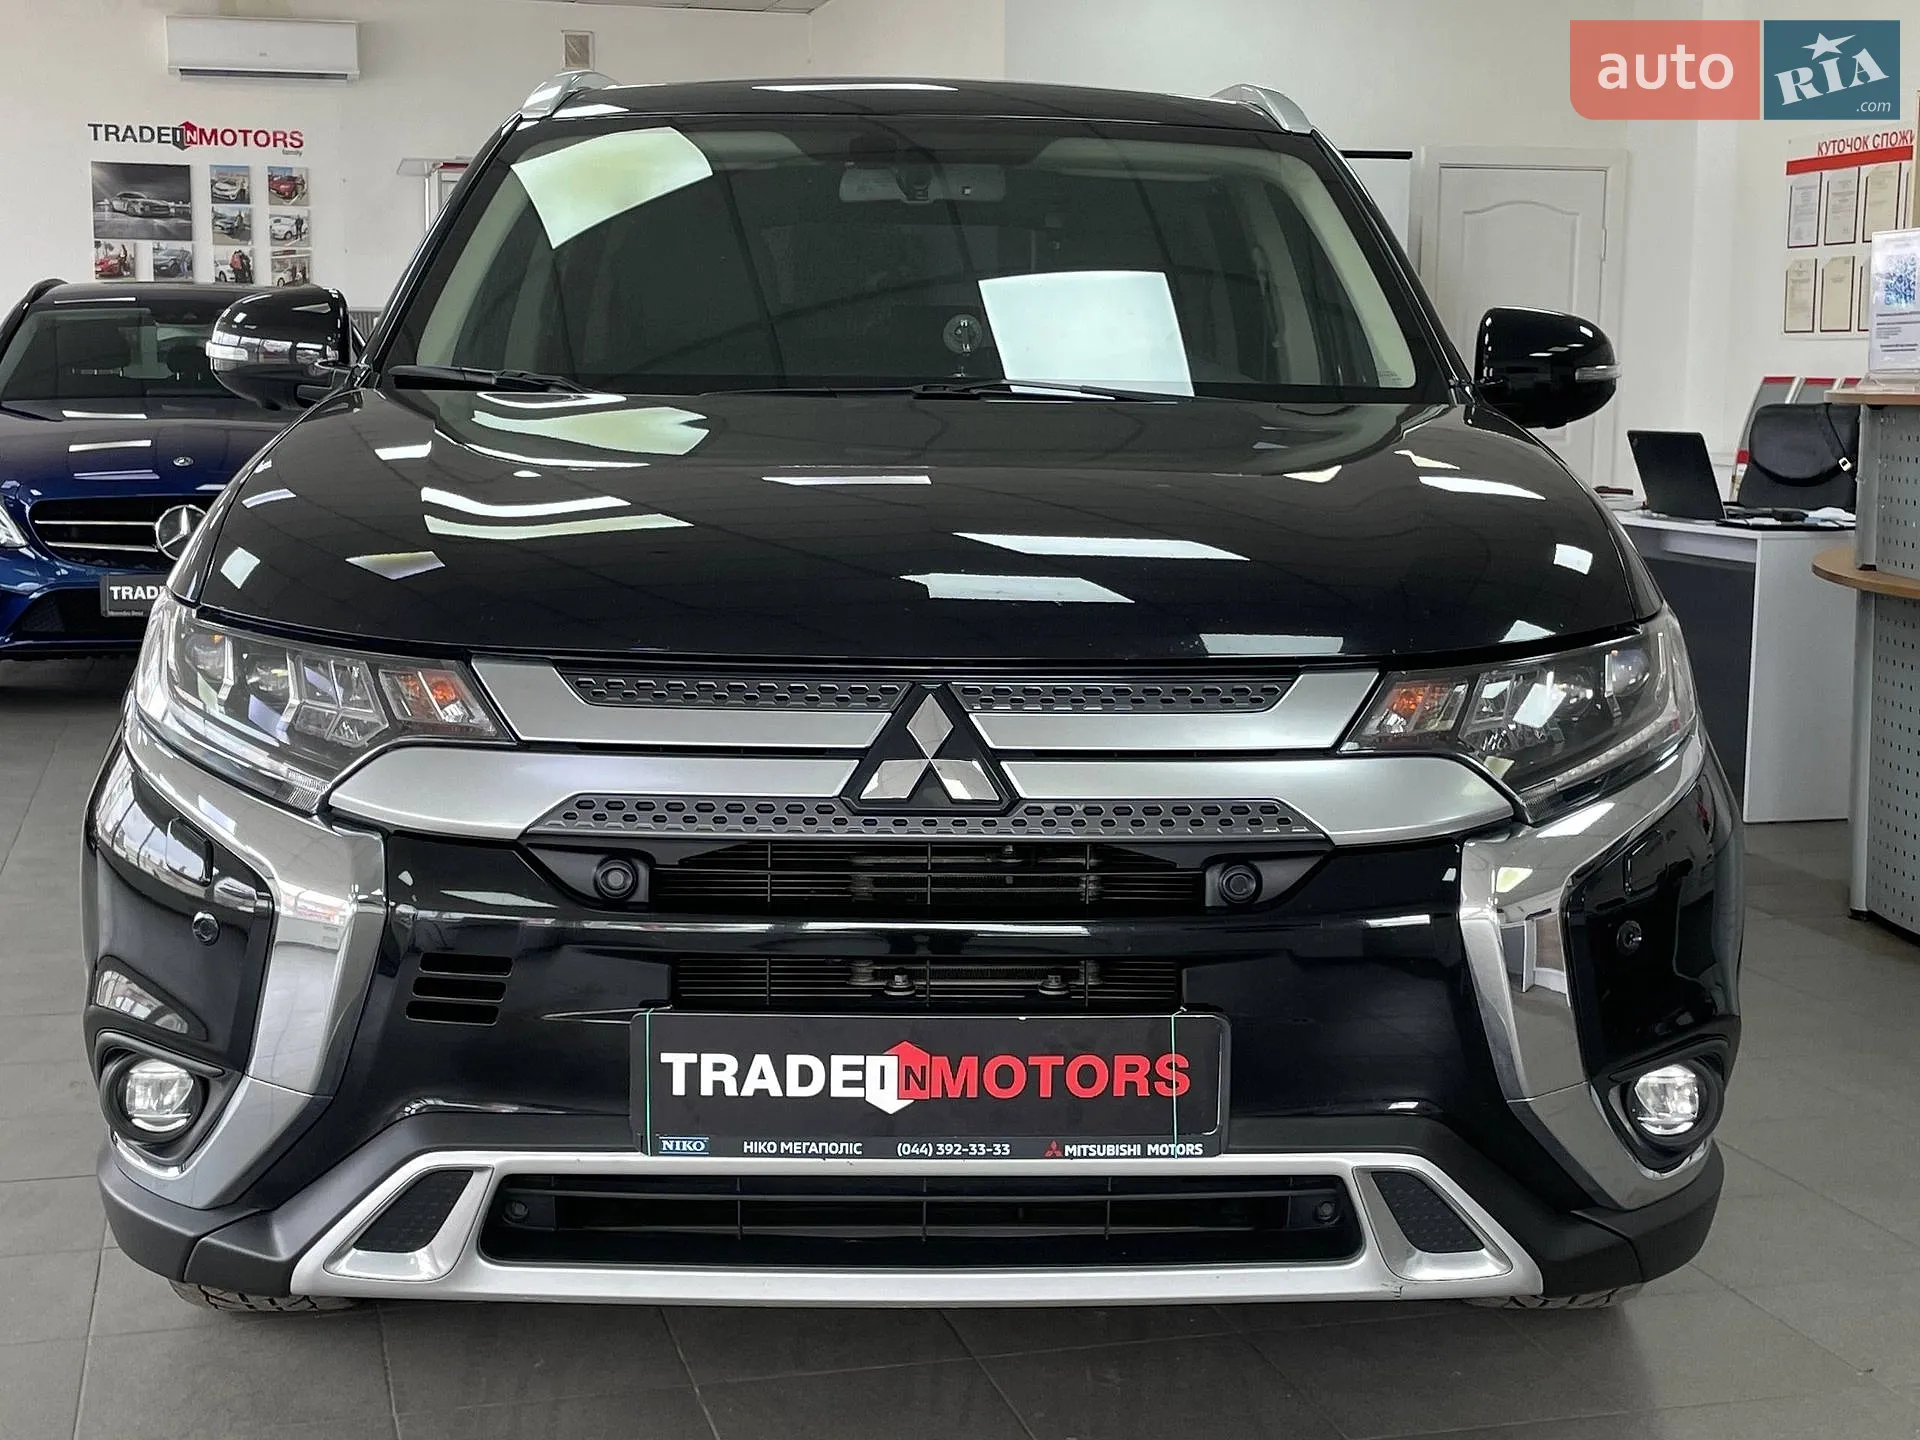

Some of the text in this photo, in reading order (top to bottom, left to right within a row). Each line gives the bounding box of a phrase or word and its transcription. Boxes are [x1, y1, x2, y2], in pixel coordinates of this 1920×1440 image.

[1817, 136, 1870, 156] КУТОЧОК
[661, 1139, 706, 1152] NIKO
[743, 1141, 863, 1155] НІКО МЕГАПОЛІС
[897, 1143, 1010, 1156] (044) 392-33-33
[1064, 1143, 1203, 1156] MITSUBISHI MOTORS
